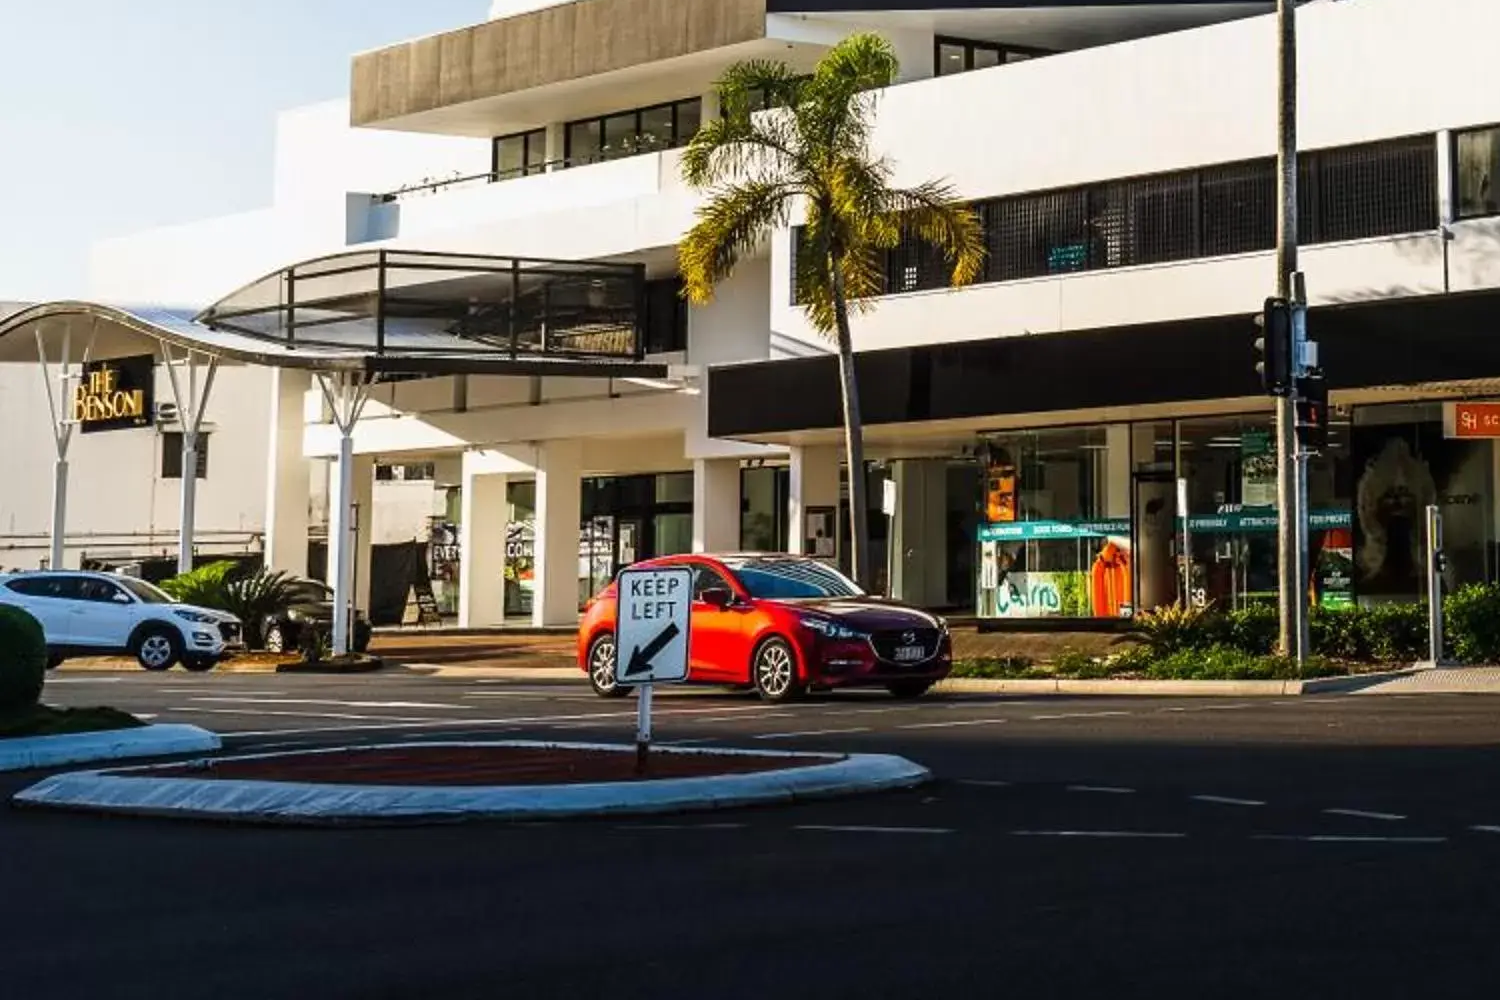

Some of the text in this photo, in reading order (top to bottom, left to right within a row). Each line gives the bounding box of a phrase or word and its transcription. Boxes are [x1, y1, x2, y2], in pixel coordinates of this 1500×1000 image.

[90, 370, 113, 393] THE
[74, 384, 143, 421] BENSON
[631, 578, 679, 596] KEEP
[631, 601, 677, 620] LEFT
